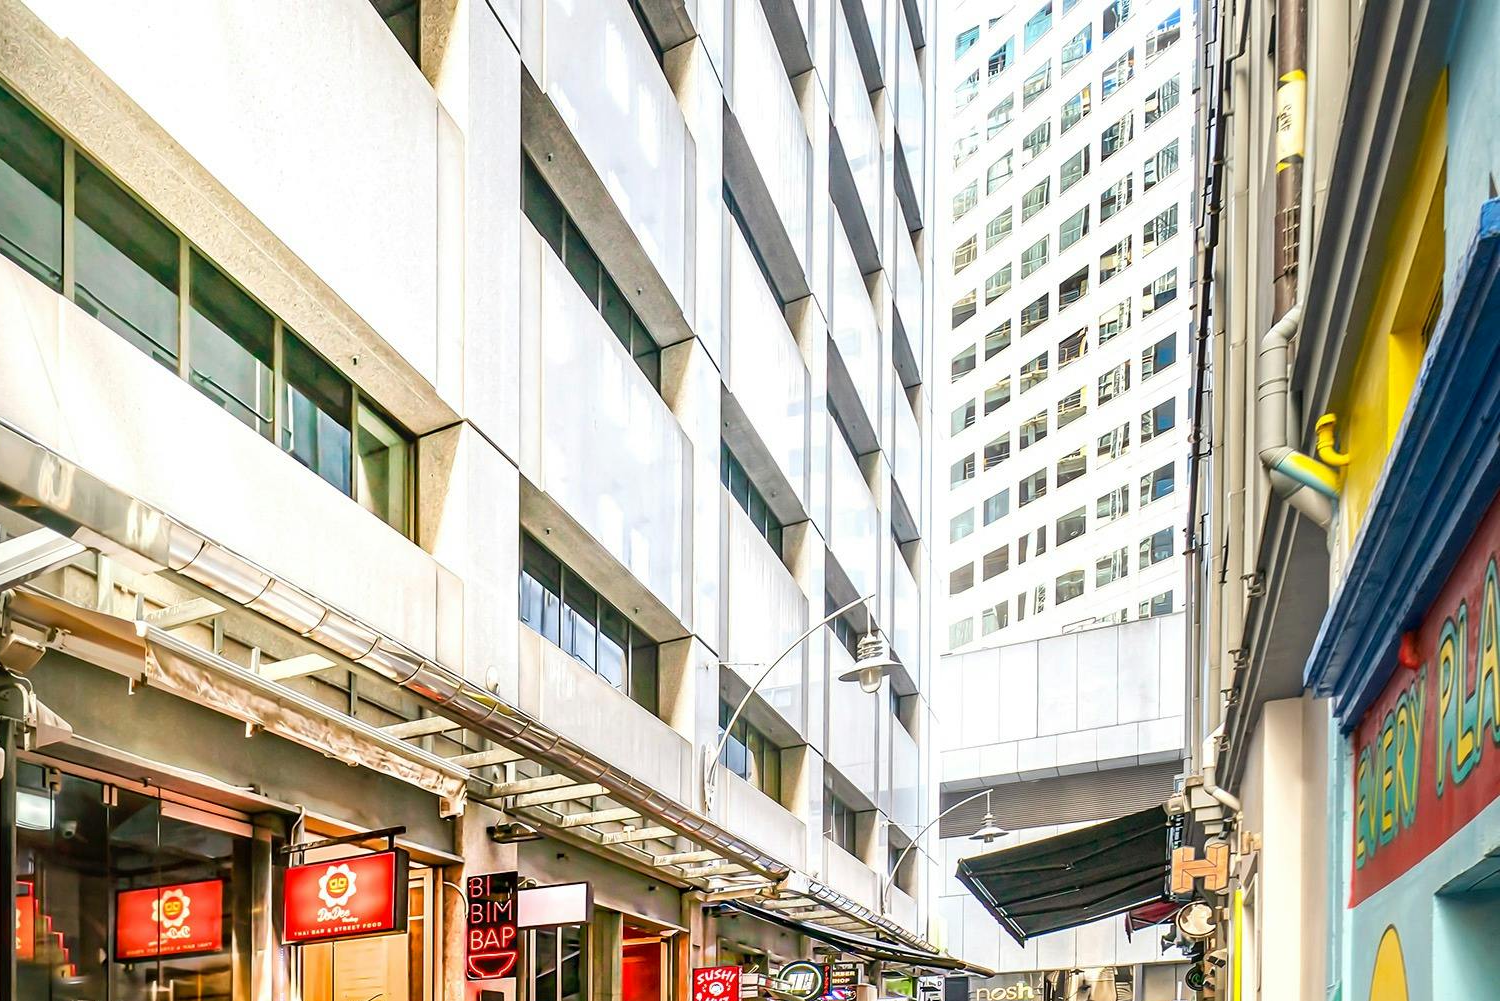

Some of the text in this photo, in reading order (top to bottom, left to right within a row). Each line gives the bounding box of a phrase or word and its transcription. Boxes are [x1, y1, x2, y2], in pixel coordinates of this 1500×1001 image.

[1355, 660, 1428, 872] EVERY
[468, 875, 491, 898] BI
[470, 899, 512, 924] BIM
[334, 924, 360, 933] STREET
[362, 921, 382, 929] FOOD
[470, 926, 515, 951] BAP
[696, 968, 737, 985] SUSHI
[976, 980, 1035, 1001] nosh
